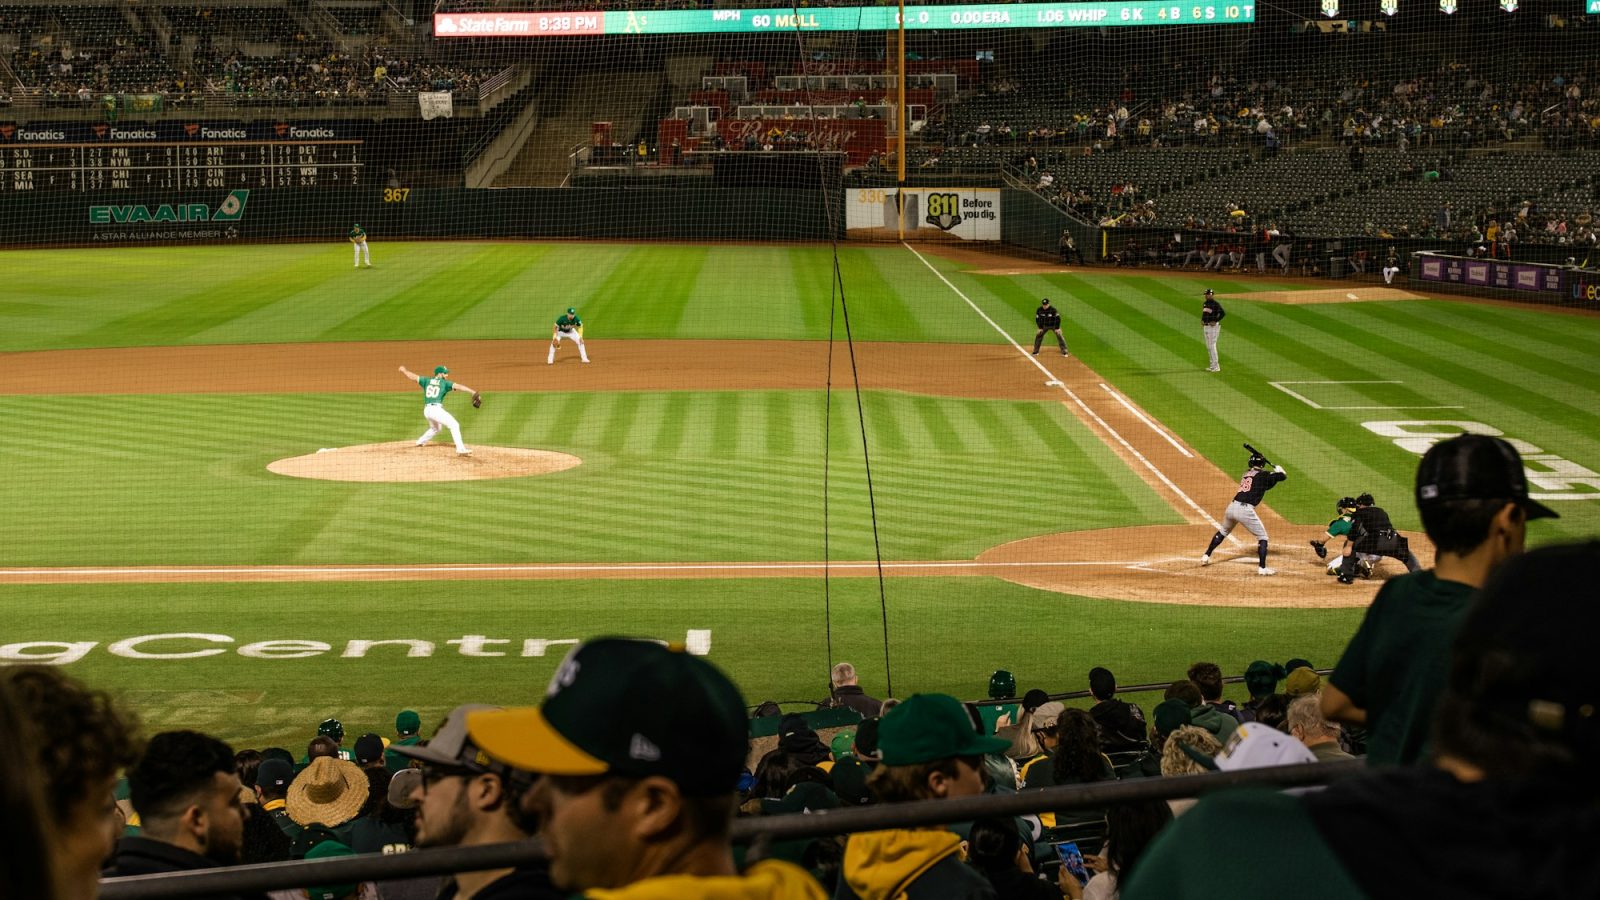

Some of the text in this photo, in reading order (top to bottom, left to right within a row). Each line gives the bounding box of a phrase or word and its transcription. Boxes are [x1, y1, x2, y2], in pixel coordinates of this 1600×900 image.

[713, 10, 741, 22] MPH
[1067, 8, 1108, 22] WHIP
[575, 16, 598, 30] PM
[752, 14, 820, 28] 60 MOLL
[17, 129, 65, 140] Fanatics
[110, 128, 157, 139] Fanatics
[201, 127, 247, 139] Fanatics
[289, 126, 335, 138] Fanatics
[14, 149, 32, 159] S.D.
[112, 148, 129, 157] PHI
[207, 147, 224, 156] ARI
[299, 146, 317, 155] DET
[16, 160, 32, 168] PIT
[110, 157, 131, 167] NYM
[207, 157, 224, 166] STL
[14, 171, 33, 180] SEA
[112, 169, 130, 179] CHI
[207, 168, 224, 177] CIN
[301, 167, 318, 176] WSH
[14, 181, 34, 191] MIA
[112, 179, 130, 189] MIL
[206, 178, 225, 187] COL
[383, 187, 410, 202] 367
[858, 189, 886, 203] 330
[927, 193, 959, 217] 811
[962, 198, 993, 208] Before
[963, 209, 996, 221] you dig.
[101, 231, 127, 240] STAR
[129, 230, 177, 240] ALLIANCE
[178, 229, 221, 239] MEMBER
[425, 384, 440, 398] 60
[0, 629, 711, 666] gCentrl
